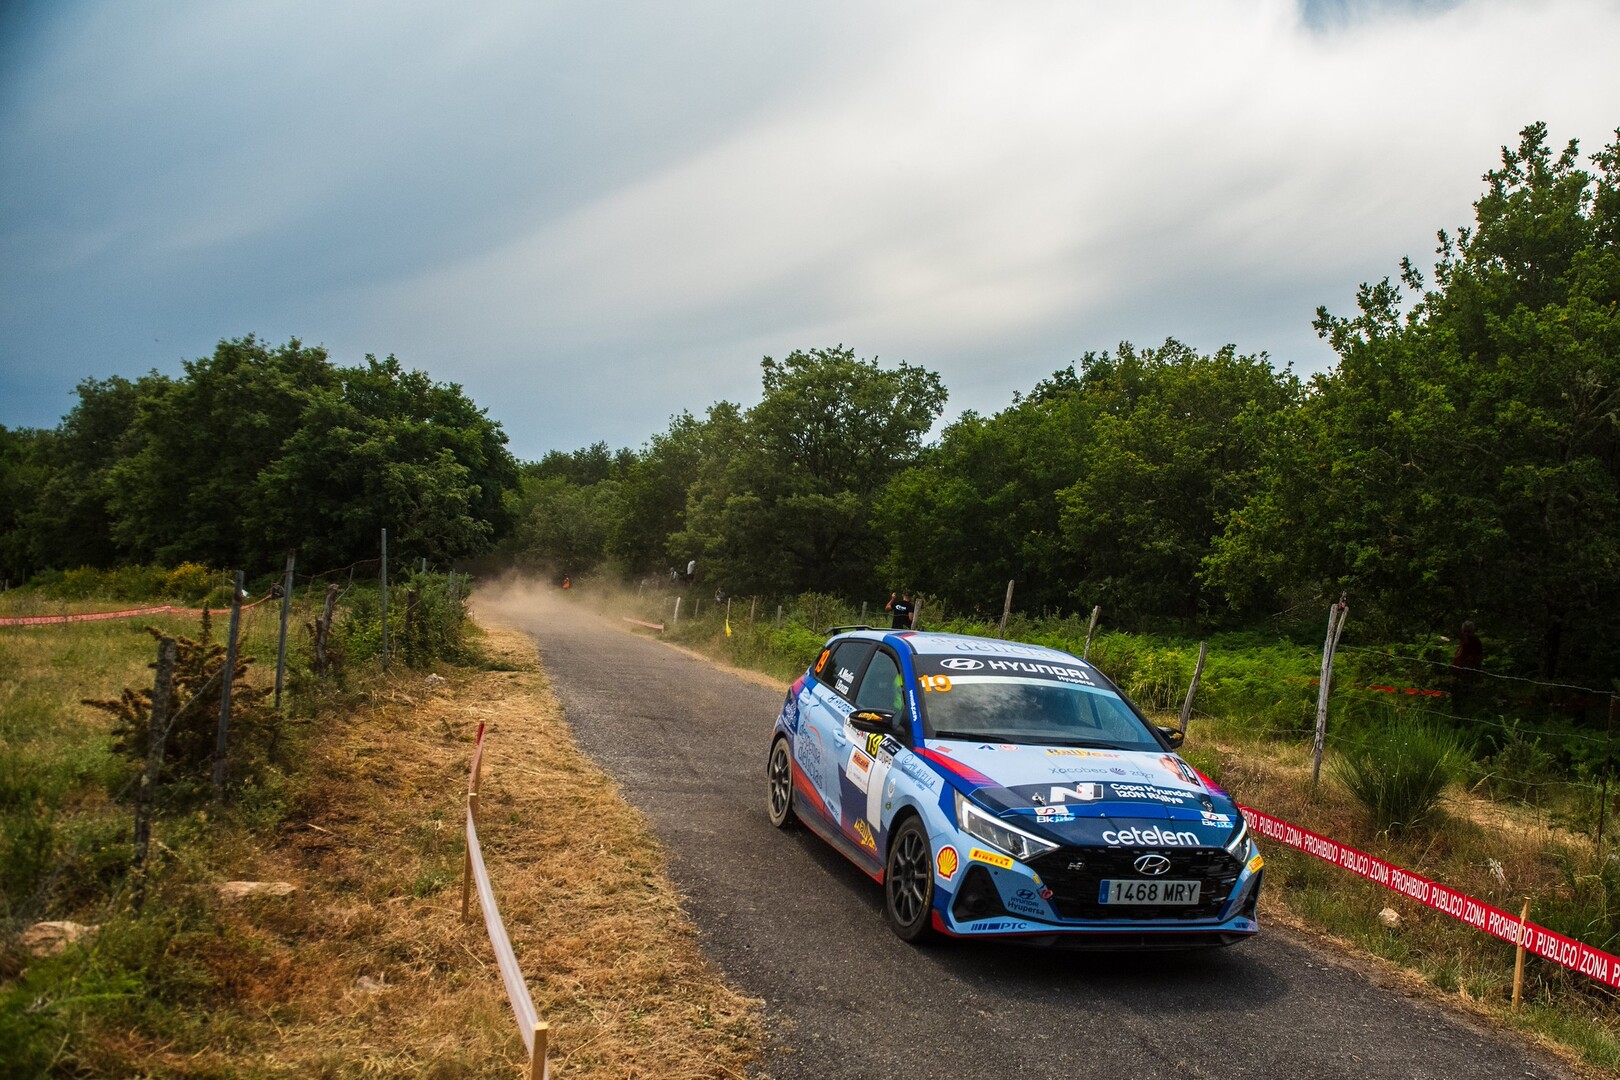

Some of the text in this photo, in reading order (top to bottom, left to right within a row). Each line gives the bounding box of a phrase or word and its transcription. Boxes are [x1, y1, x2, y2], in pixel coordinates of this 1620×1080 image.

[987, 660, 1090, 680] HYUNDAI
[918, 674, 953, 693] 19
[867, 733, 883, 756] 19
[1049, 766, 1108, 775] Xacobeo
[1110, 783, 1195, 799] Copa Hyundai
[1102, 825, 1201, 846] cetelem
[973, 850, 1010, 866] PIRELLI
[1115, 883, 1198, 902] 1468 MRY
[1259, 816, 1284, 840] PUBLICO
[1285, 826, 1302, 849] ZONA
[1303, 834, 1339, 862] PROHIBIDO
[1339, 848, 1370, 875] PUBLICO
[1370, 860, 1389, 885] ZONA
[1390, 870, 1429, 901] PROHIBIDO
[1430, 886, 1463, 917] PUBLICO
[1464, 901, 1486, 929] ZONA
[1535, 932, 1578, 968] PUBLICO
[1579, 950, 1608, 981] ZONA
[1007, 901, 1045, 916] Hyupersa
[1010, 897, 1039, 908] HYUNDAI
[1000, 922, 1027, 930] PTC
